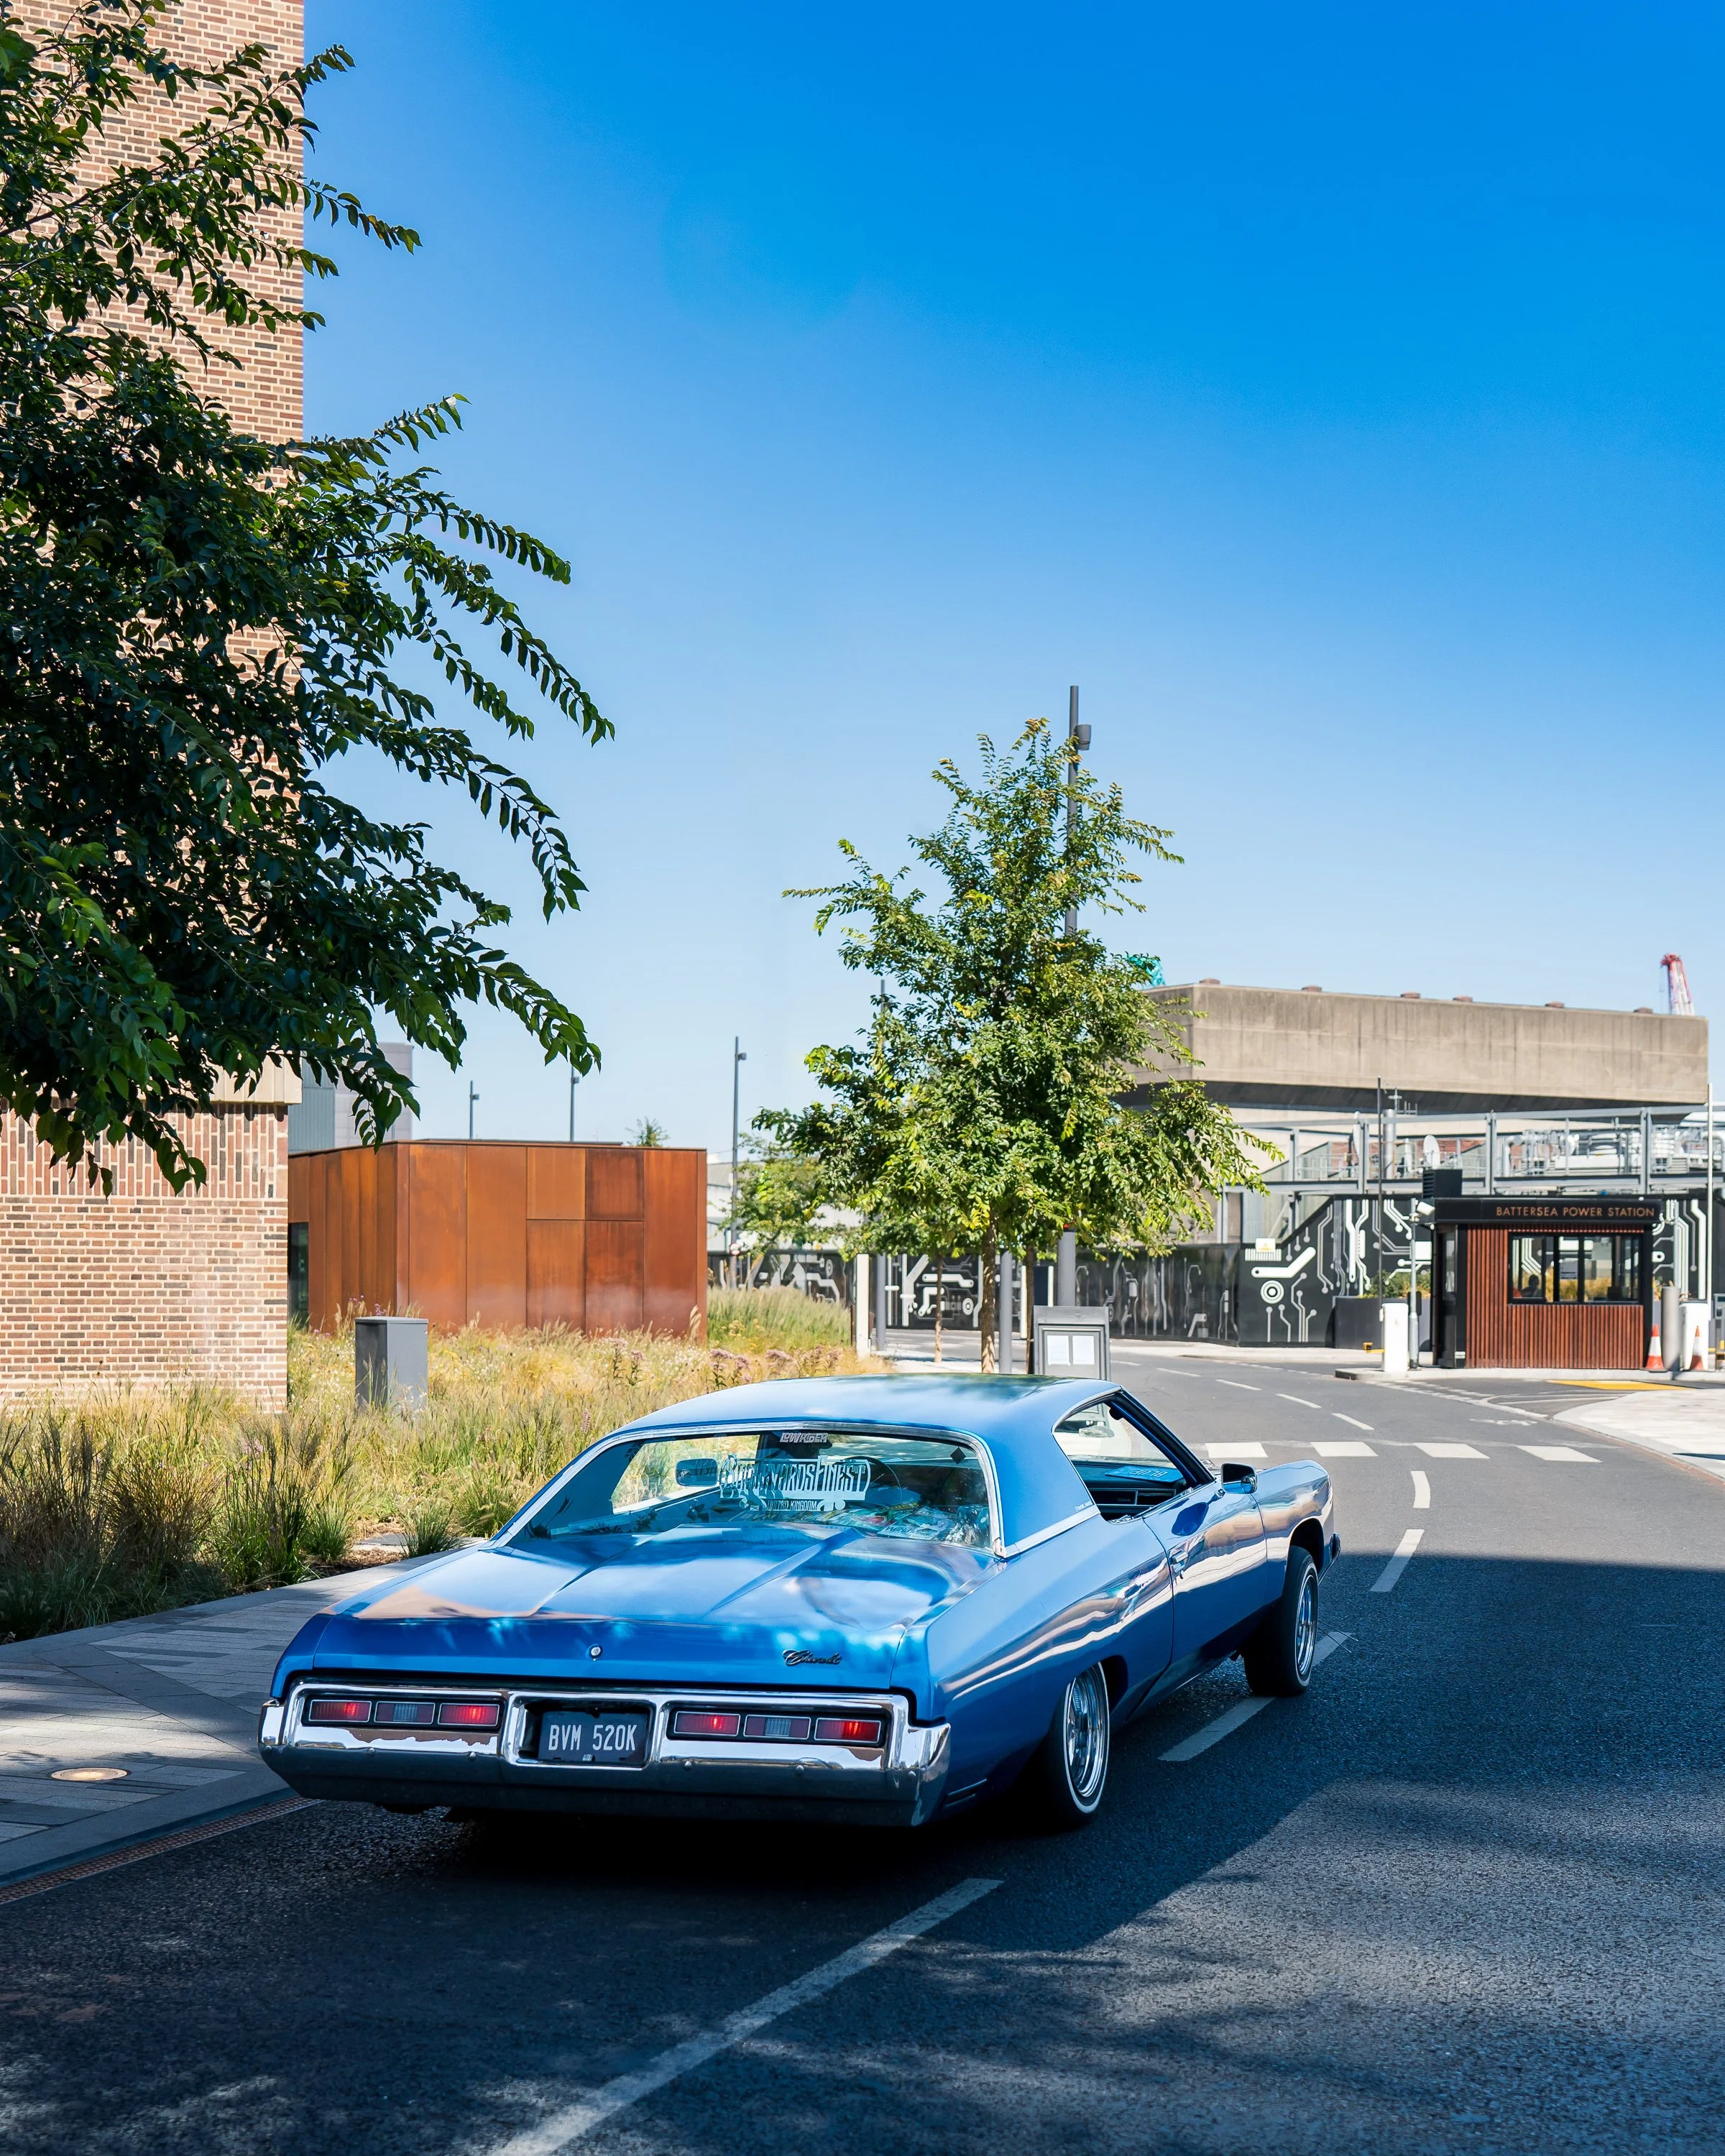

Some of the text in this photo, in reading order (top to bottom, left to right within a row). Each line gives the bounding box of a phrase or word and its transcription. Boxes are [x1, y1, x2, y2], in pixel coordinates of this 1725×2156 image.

[1496, 1207, 1655, 1217] BATTERSEA POWER STATION
[791, 1500, 817, 1510] KINGDOM
[548, 1725, 637, 1751] BVM 520K
